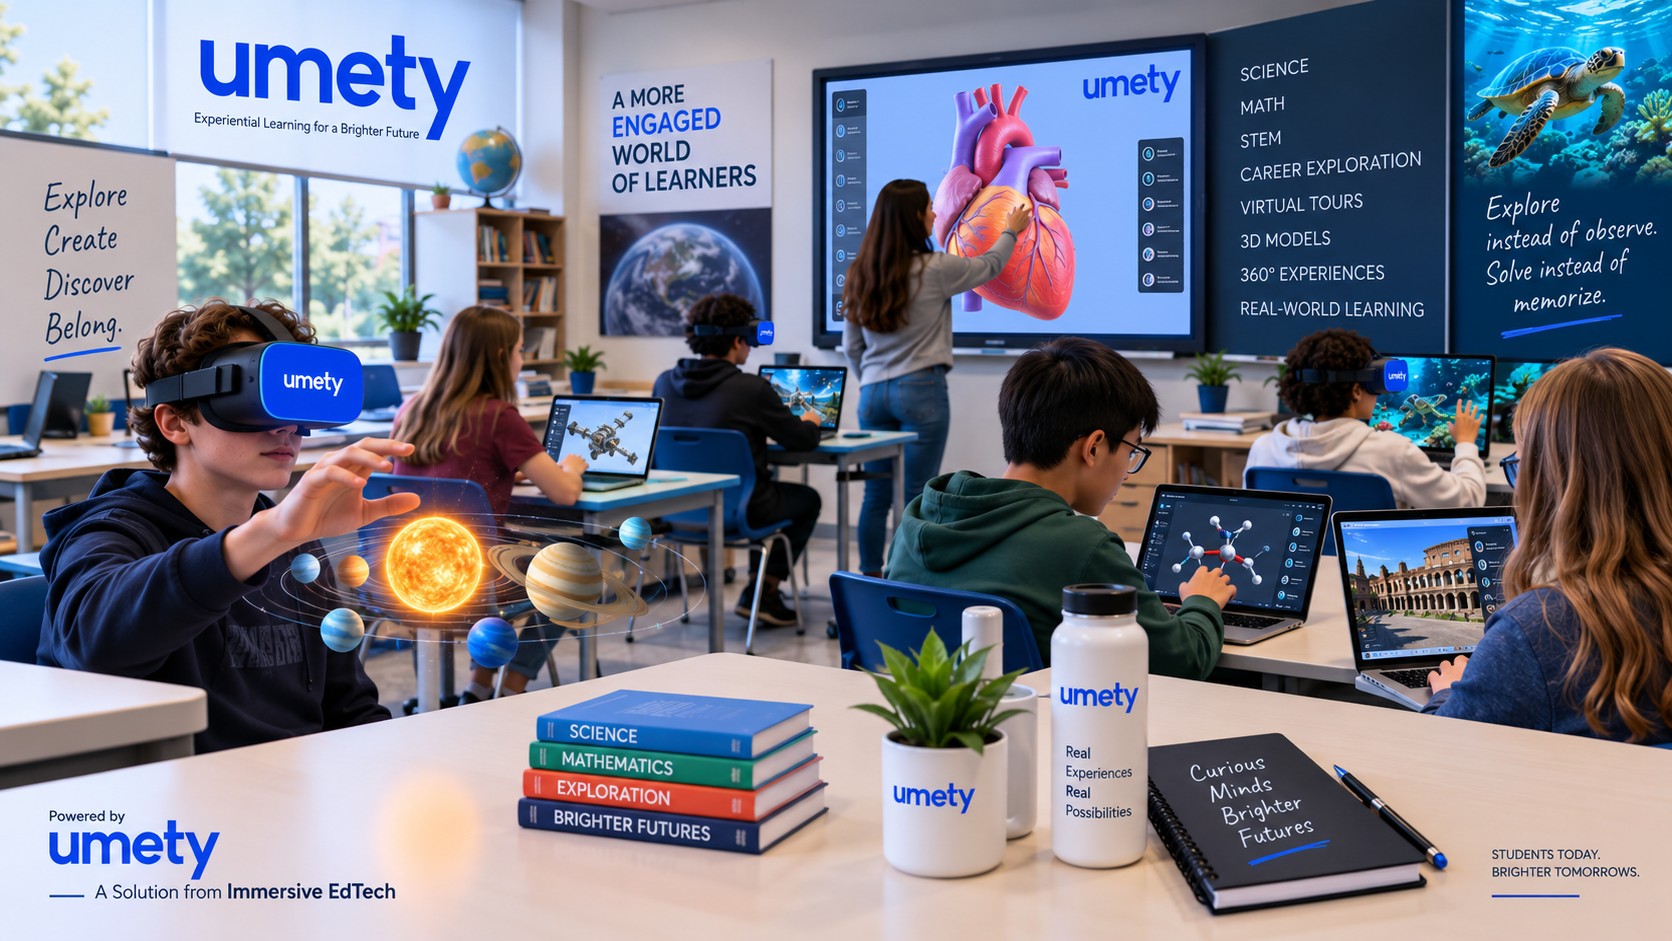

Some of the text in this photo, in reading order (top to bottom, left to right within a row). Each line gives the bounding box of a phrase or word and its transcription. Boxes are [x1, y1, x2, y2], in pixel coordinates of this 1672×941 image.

[1241, 58, 1308, 81] SCIENCE
[200, 35, 471, 140] umety
[612, 84, 684, 109] A MORE
[1083, 64, 1181, 103] umety
[1241, 96, 1284, 115] MATH
[194, 111, 420, 140] Experiential Learning for a Brighter Future
[613, 108, 721, 137] ENGAGED
[612, 140, 690, 165] WORLD
[1240, 130, 1281, 149] STEM
[612, 164, 756, 193] OF LEARNERS
[1241, 151, 1421, 181] CAREER EXPLORATION
[44, 180, 127, 218] Explore
[1240, 192, 1364, 215] VIRTUAL TOURS
[1487, 192, 1559, 225] Explore
[45, 225, 117, 255] Create
[1240, 230, 1331, 249] 3D MODELS
[1487, 218, 1656, 251] instead of observe.
[1240, 264, 1385, 283] 360° EXPERIENCES
[1487, 248, 1629, 285] Solve instead of
[44, 269, 134, 300] Discover
[1240, 300, 1425, 318] REAL-WORLD LEARNING
[1514, 287, 1605, 312] memorize.
[46, 311, 121, 345] Belong.
[284, 372, 343, 396] umety
[1061, 683, 1138, 713] umety
[570, 724, 637, 743] SCIENCE
[563, 752, 673, 775] MATHEMATICS
[1066, 745, 1091, 760] Real
[1066, 764, 1133, 782] Experiences
[1190, 756, 1266, 783] Curious
[557, 780, 670, 806] EXPLORATION
[894, 783, 975, 814] umety
[1066, 784, 1091, 799] Real
[1210, 777, 1273, 804] Minds
[1066, 803, 1133, 819] Possibilities
[1221, 797, 1302, 827] Brighter
[555, 810, 632, 832] BRIGHTER
[638, 819, 710, 841] FUTURES
[1238, 817, 1314, 849] Futures
